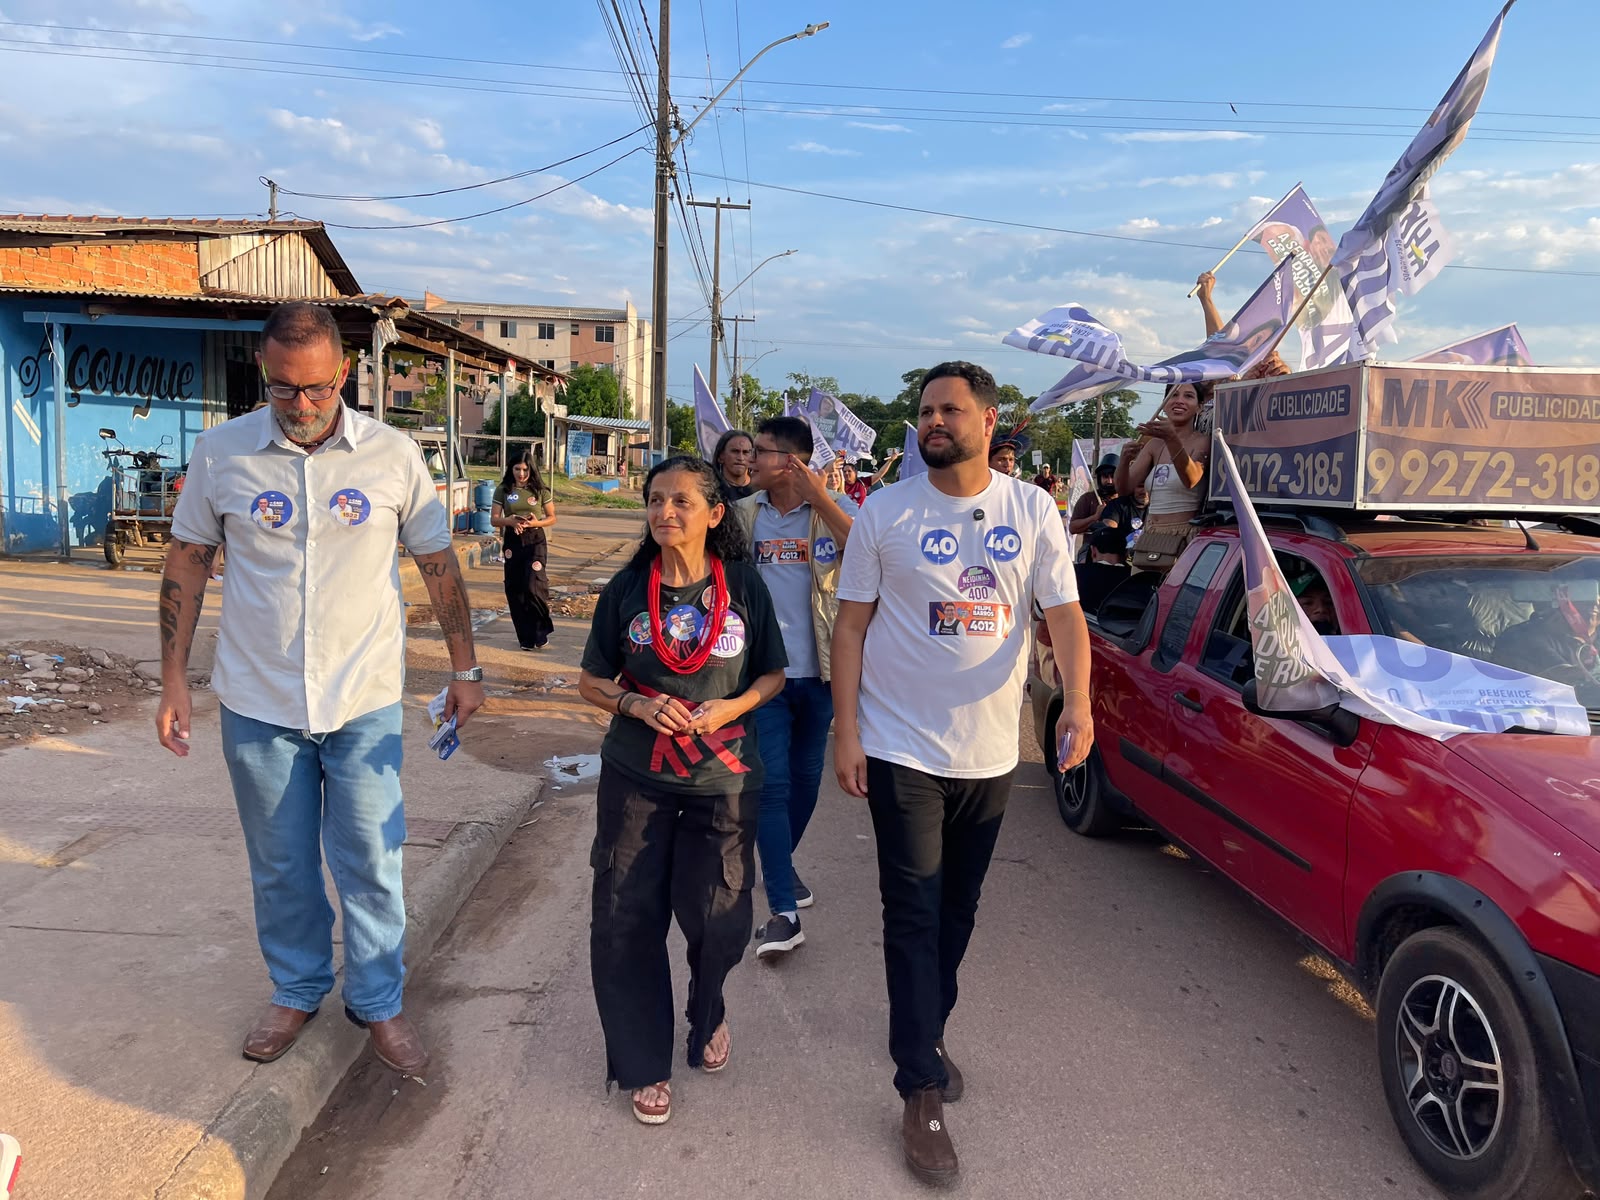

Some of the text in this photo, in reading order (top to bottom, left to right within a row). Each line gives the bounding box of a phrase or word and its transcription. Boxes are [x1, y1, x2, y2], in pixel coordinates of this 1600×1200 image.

[19, 324, 195, 420] Açougue
[1270, 389, 1346, 418] PUBLICIDADE
[1381, 378, 1476, 429] MK
[839, 406, 876, 440] NEIDINHA
[1217, 451, 1345, 497] 9272-3185
[1367, 448, 1600, 501] 99272-318
[815, 541, 836, 557] 40
[923, 536, 957, 555] 40
[986, 533, 1020, 553] 40
[780, 551, 798, 560] 4012
[968, 586, 988, 601] 400
[970, 620, 995, 632] 4012
[713, 635, 737, 652] 400
